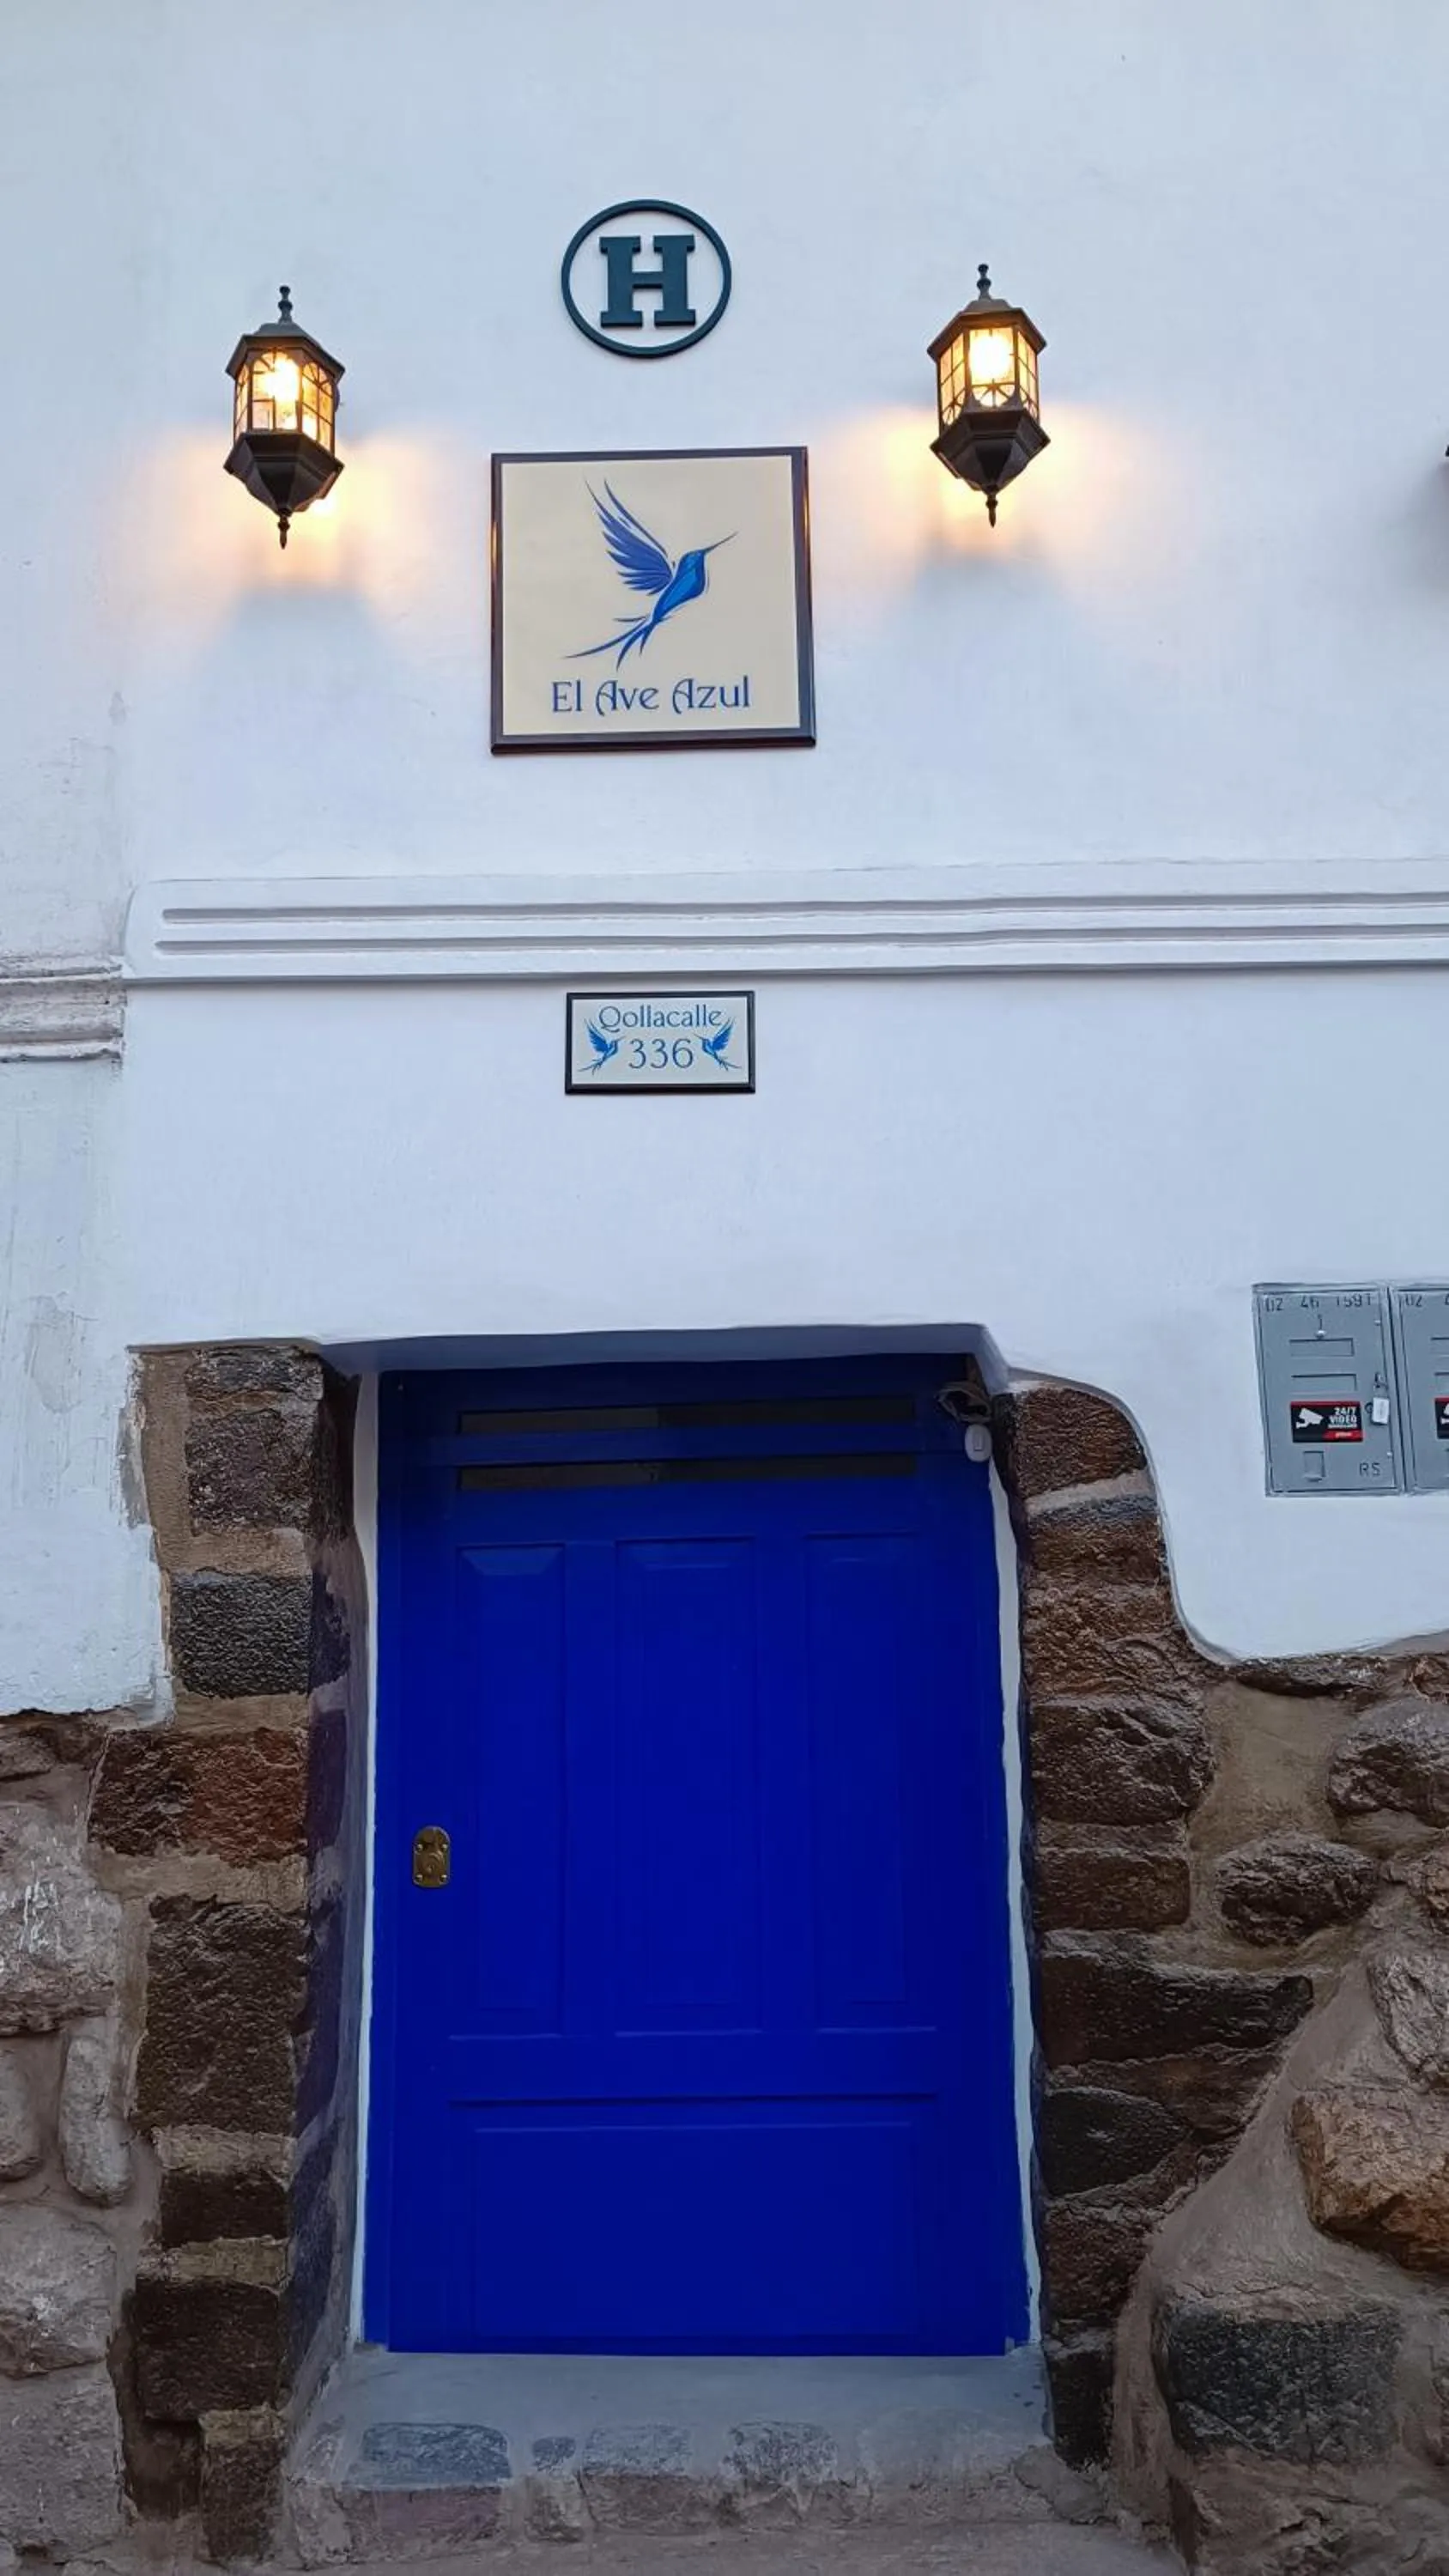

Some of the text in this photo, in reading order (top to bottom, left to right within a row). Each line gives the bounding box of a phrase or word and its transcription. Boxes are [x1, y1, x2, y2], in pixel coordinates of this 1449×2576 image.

[599, 234, 696, 328] H
[551, 675, 750, 716] El Ave Azul
[598, 1004, 723, 1033] Qollacalle
[628, 1038, 694, 1069] 336
[1329, 1415, 1357, 1424] VIDEO
